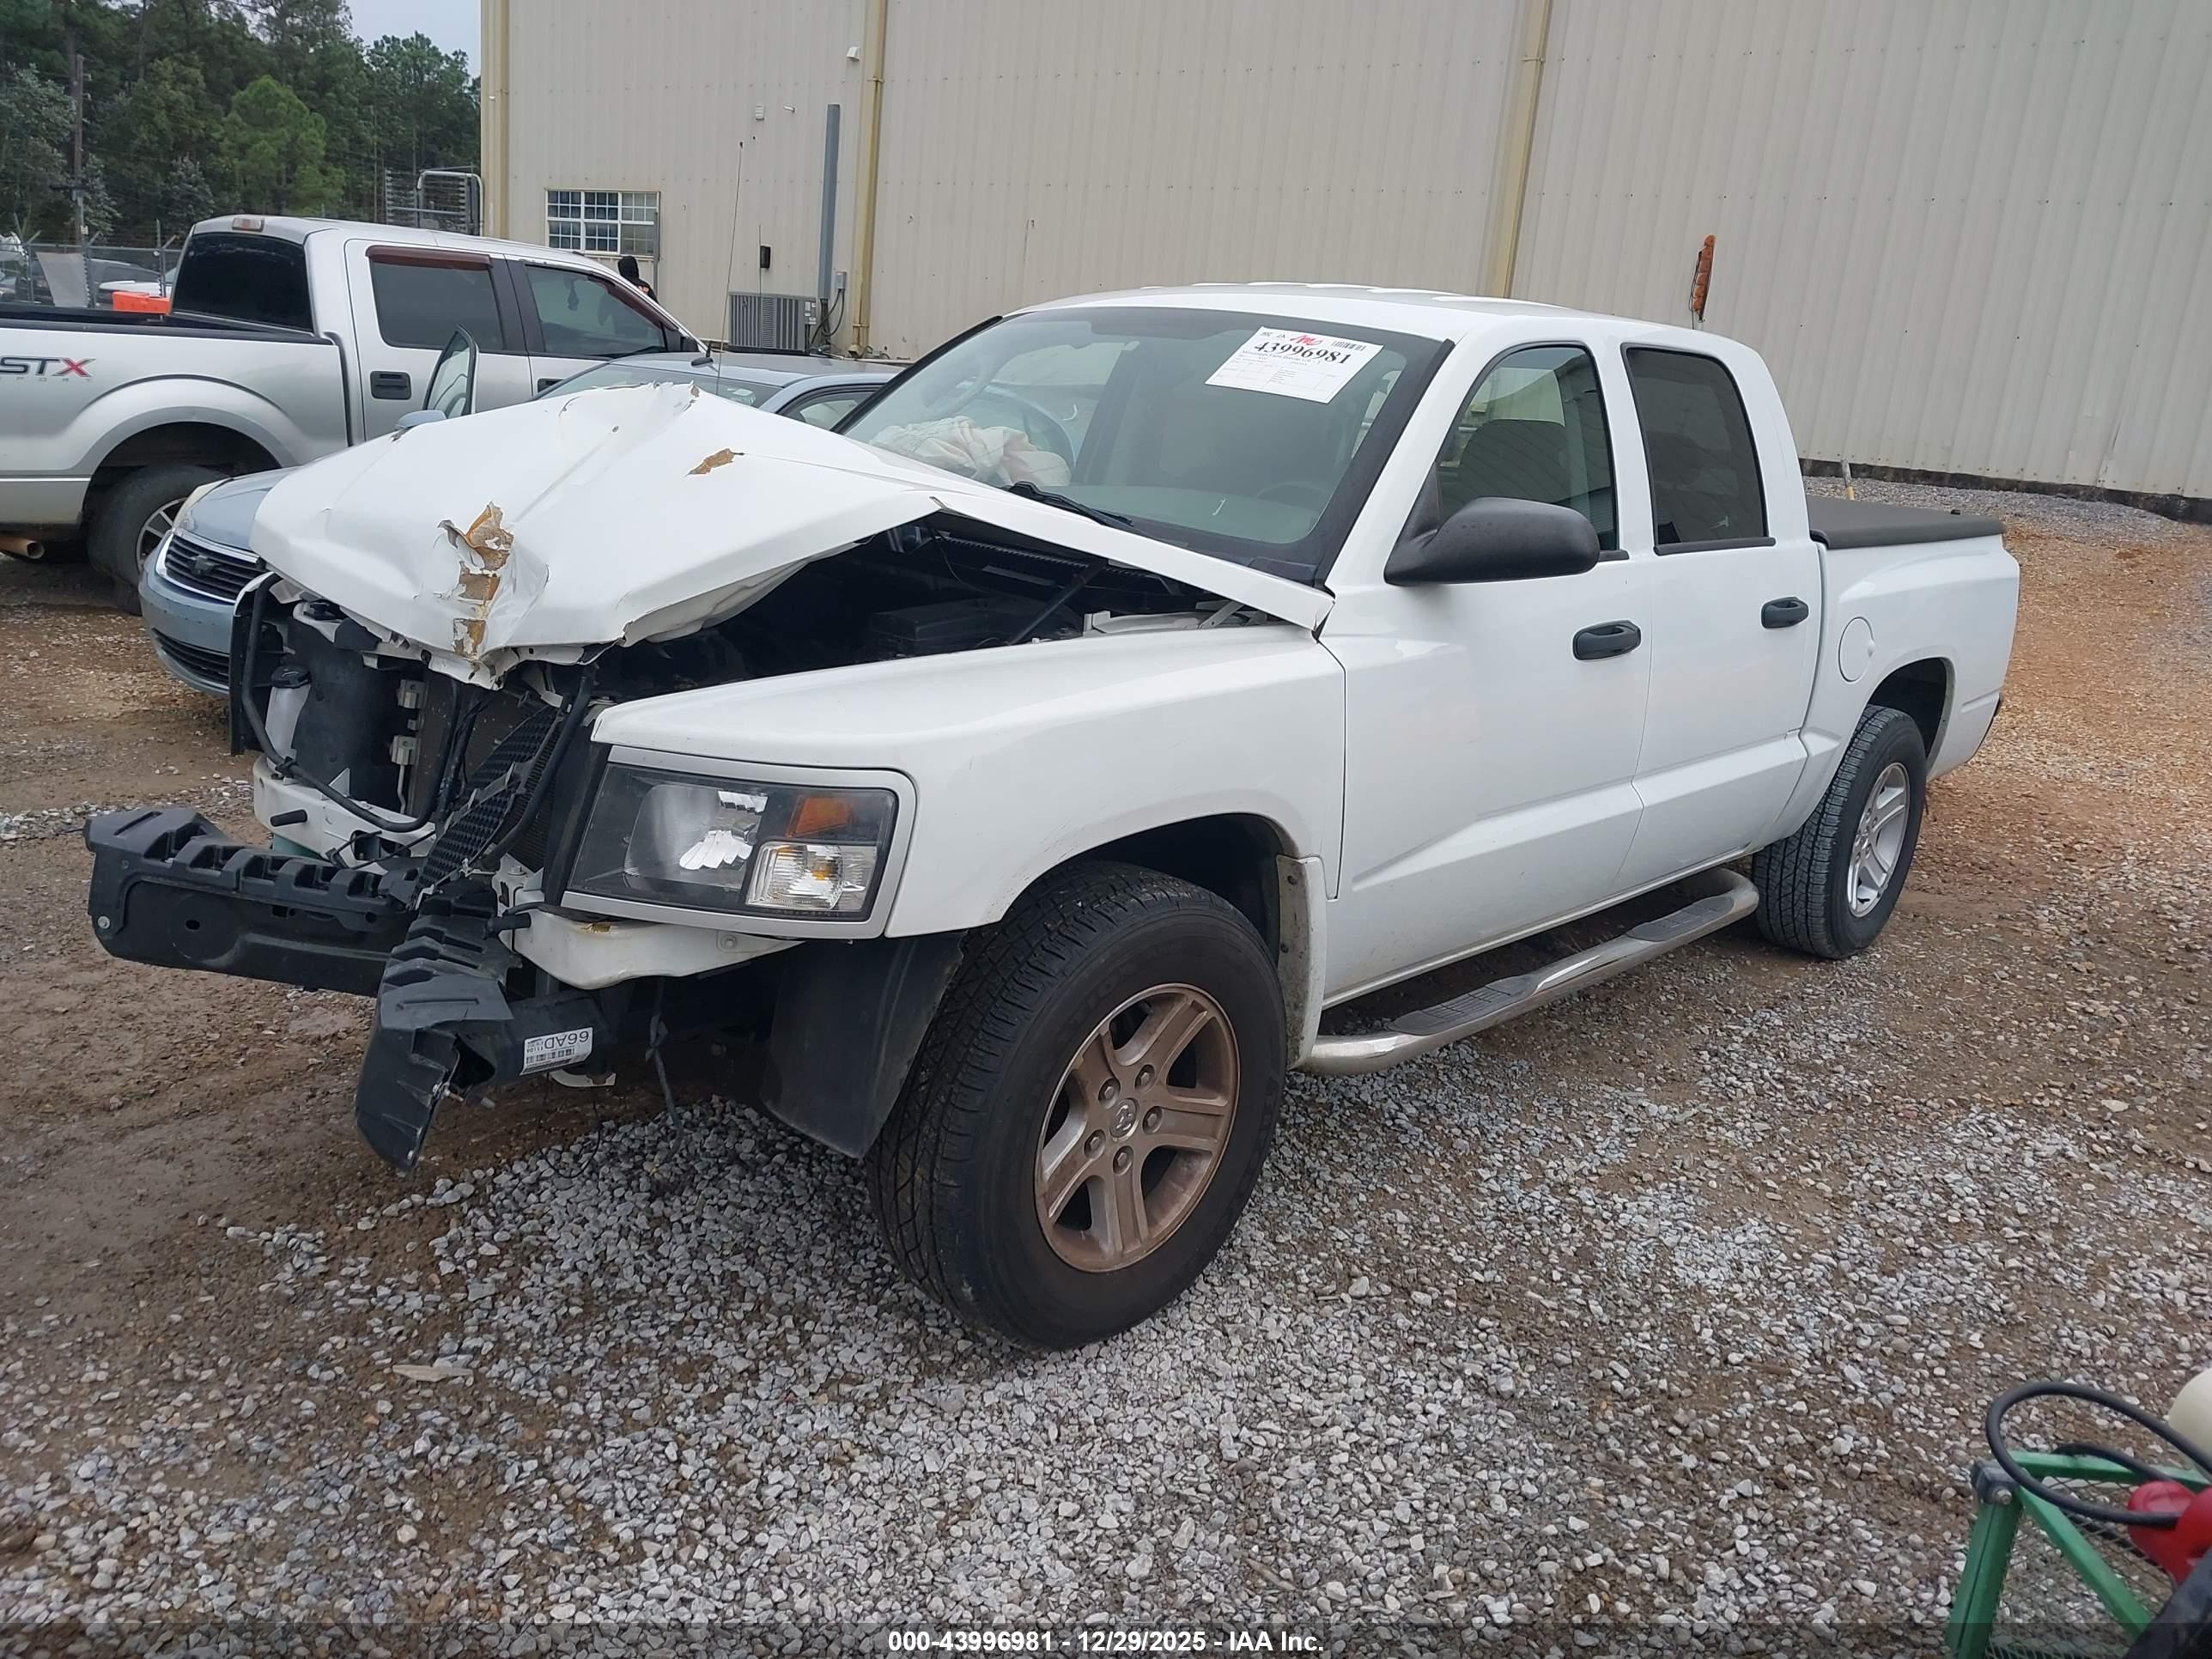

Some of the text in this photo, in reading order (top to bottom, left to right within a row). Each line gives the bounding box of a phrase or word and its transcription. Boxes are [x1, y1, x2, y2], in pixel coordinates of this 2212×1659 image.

[1255, 342, 1351, 363] 43996981
[0, 356, 96, 377] STX
[544, 1030, 589, 1048] 66AD
